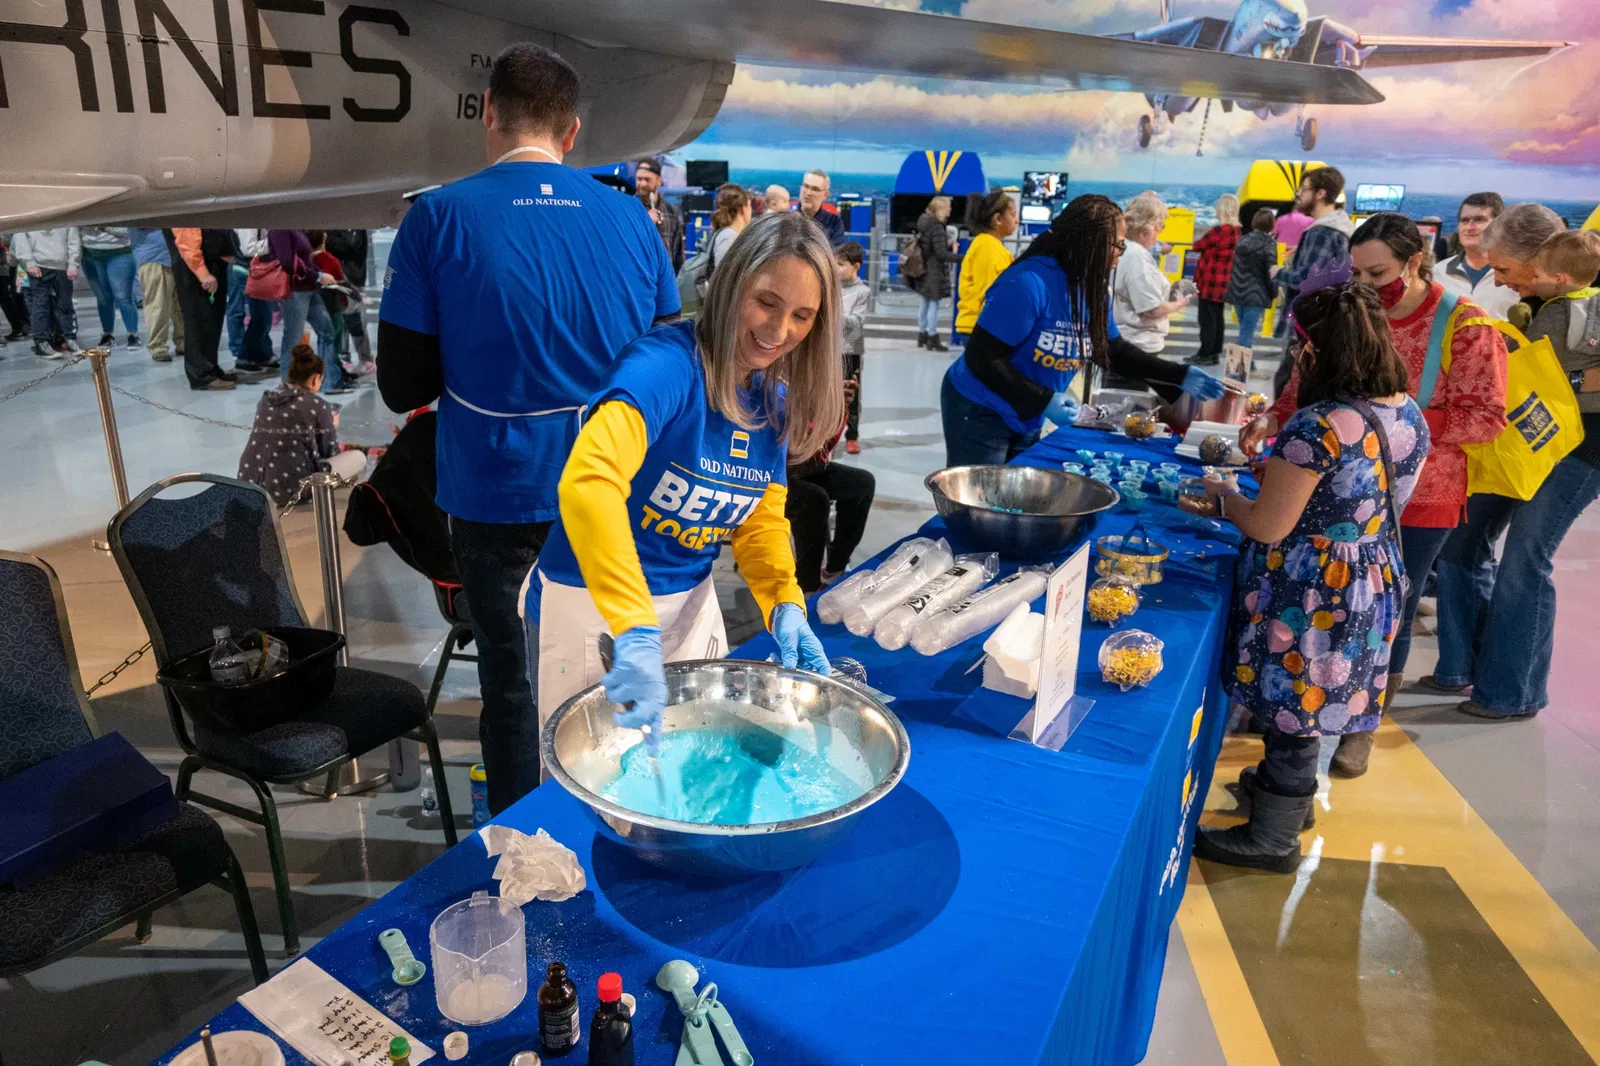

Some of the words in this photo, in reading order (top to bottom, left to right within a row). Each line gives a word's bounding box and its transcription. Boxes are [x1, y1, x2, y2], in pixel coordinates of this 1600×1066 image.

[513, 198, 533, 206] OLD
[535, 198, 582, 207] NATIONAL
[700, 457, 720, 474] OLD
[722, 463, 774, 482] NATIONA
